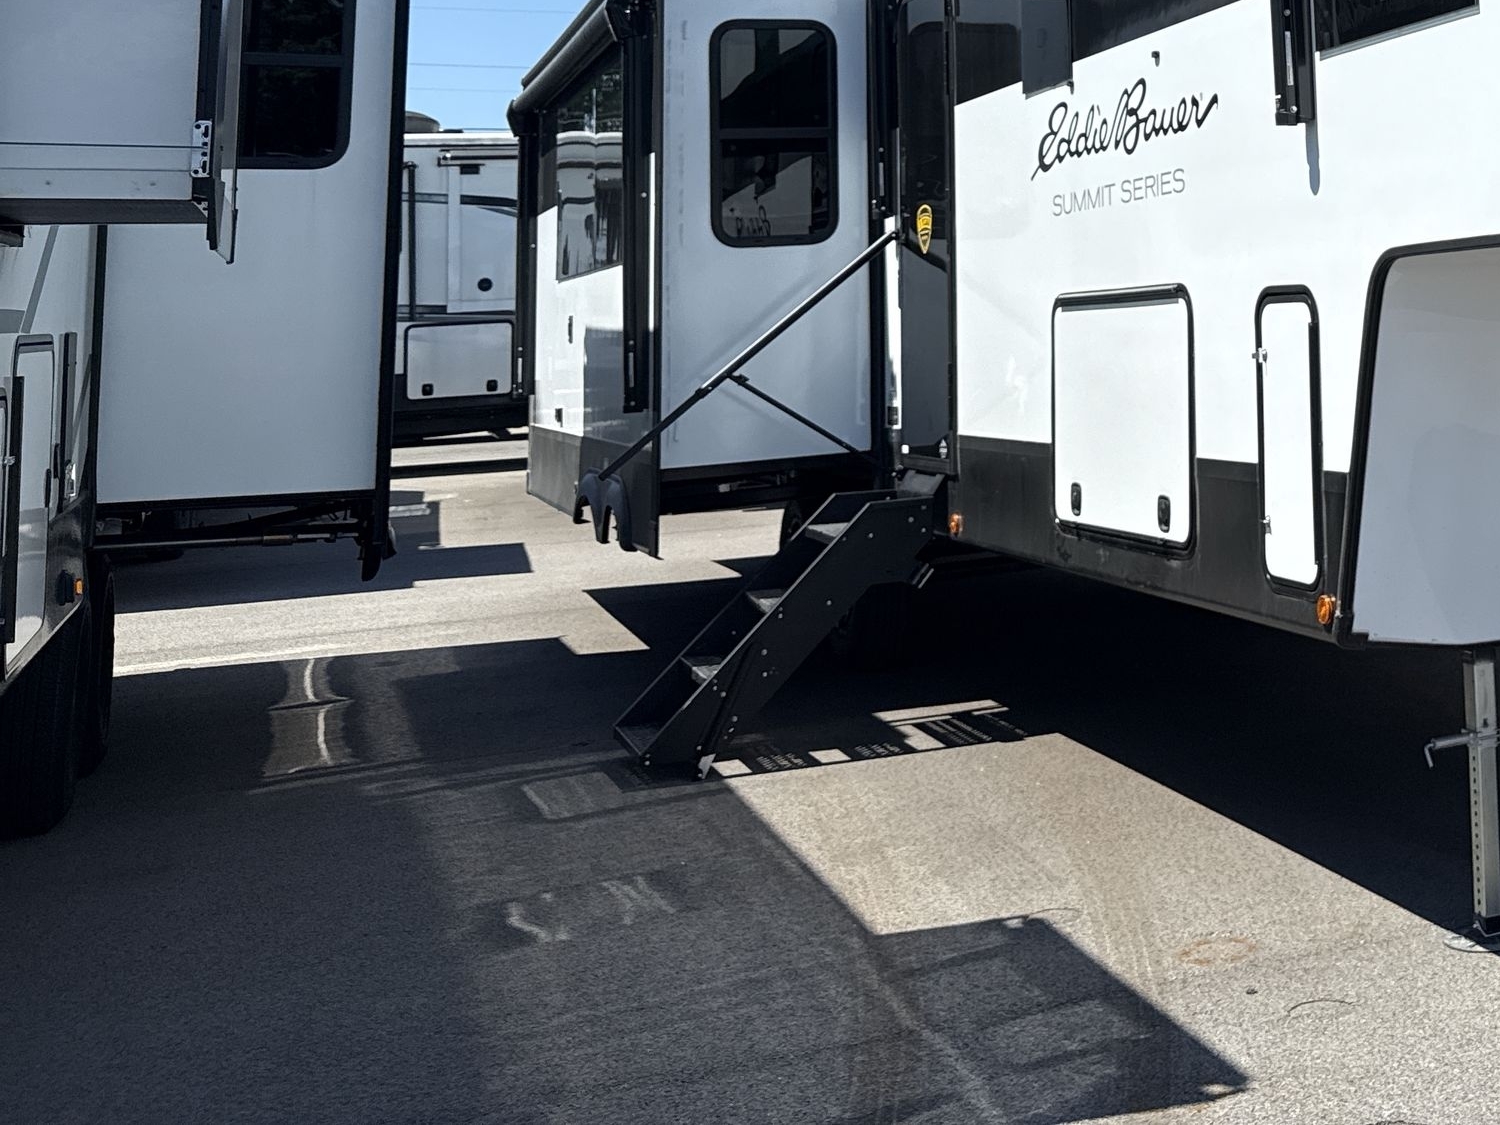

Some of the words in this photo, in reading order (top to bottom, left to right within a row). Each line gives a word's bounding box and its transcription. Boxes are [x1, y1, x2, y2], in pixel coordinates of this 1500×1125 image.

[1030, 101, 1109, 181] Eddie
[1110, 77, 1219, 156] Bauer
[1052, 182, 1116, 217] SUMMIT
[1120, 168, 1186, 204] SERIES
